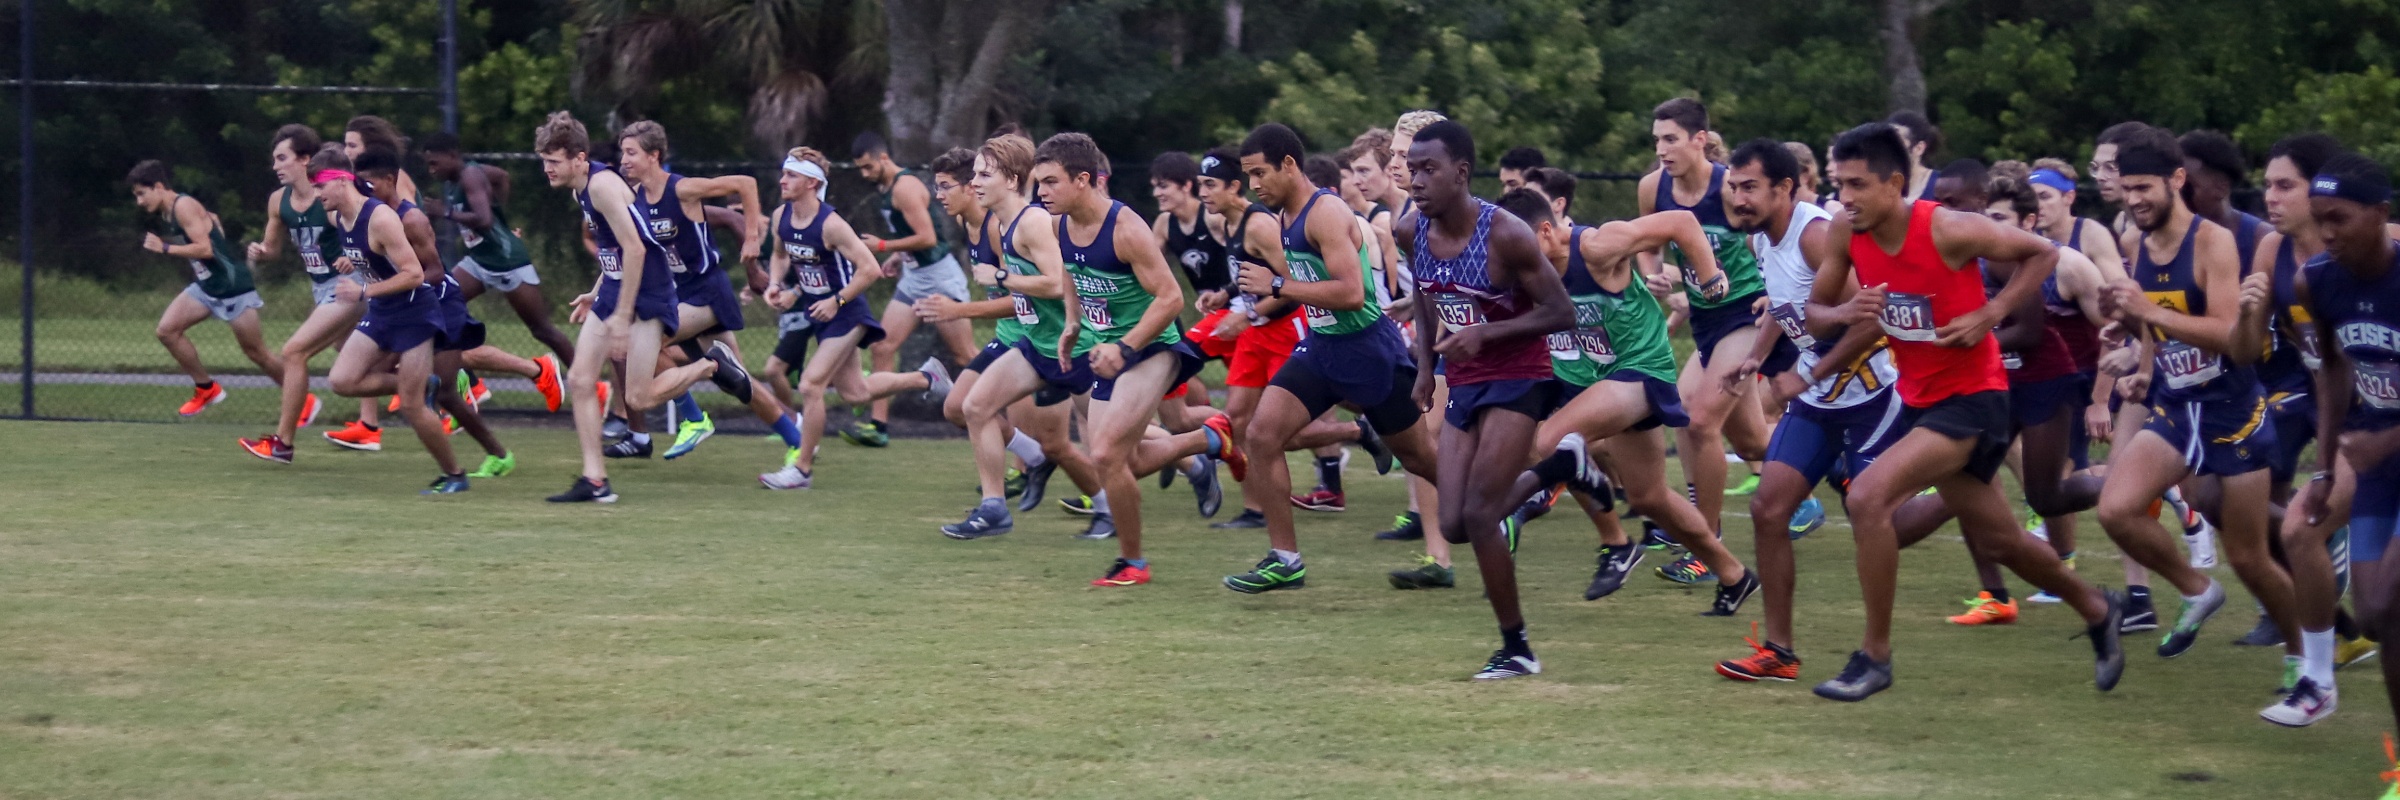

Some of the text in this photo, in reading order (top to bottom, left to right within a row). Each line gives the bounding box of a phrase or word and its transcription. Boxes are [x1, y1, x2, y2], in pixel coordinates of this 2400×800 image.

[598, 254, 618, 273] 1359
[799, 271, 823, 288] 1361
[1080, 303, 1107, 324] 1297
[1435, 303, 1475, 324] 1357
[1882, 304, 1923, 328] 1381
[1574, 333, 1607, 355] 1296
[2163, 347, 2207, 376] 1372
[2355, 369, 2399, 399] 1326
